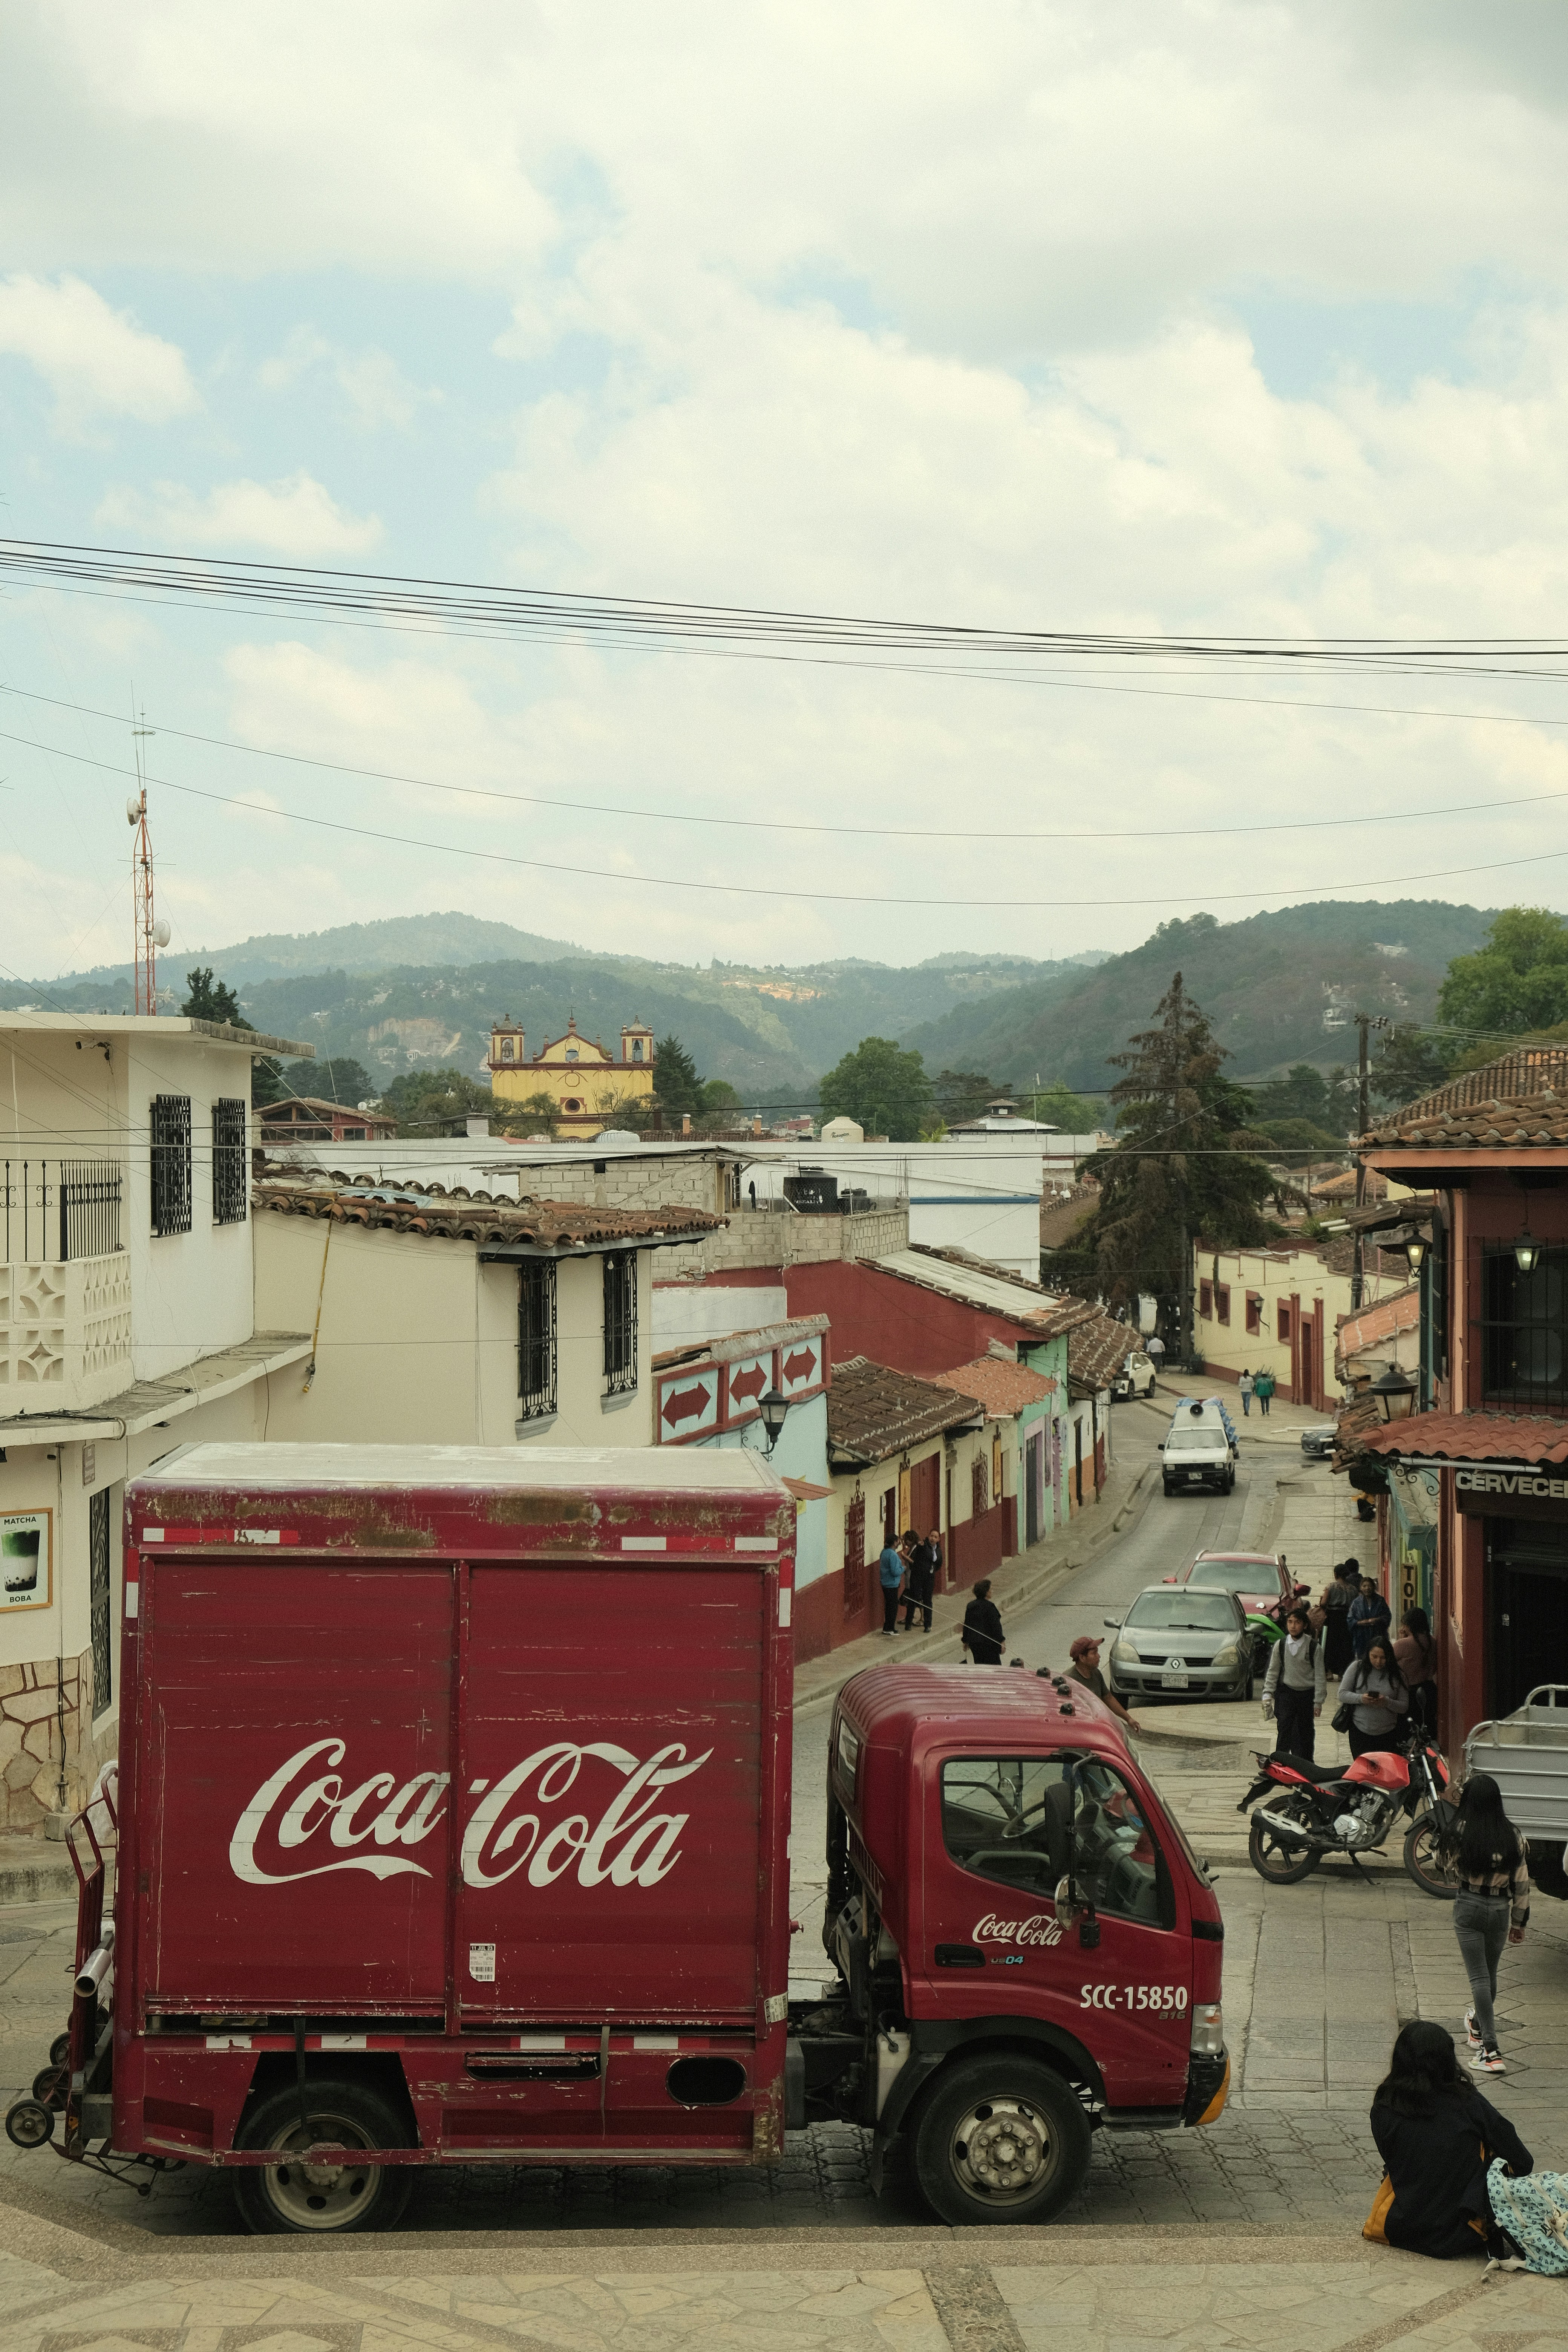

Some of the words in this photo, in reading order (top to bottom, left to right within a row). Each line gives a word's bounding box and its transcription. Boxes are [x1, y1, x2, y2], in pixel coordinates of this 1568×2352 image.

[1456, 1471, 1568, 1498] CERVECE
[4, 1516, 37, 1525] MATCHA
[972, 1914, 1063, 1946] Coca-Cola
[1080, 1984, 1188, 2010] SCC-15850
[1158, 2011, 1187, 2020] 816
